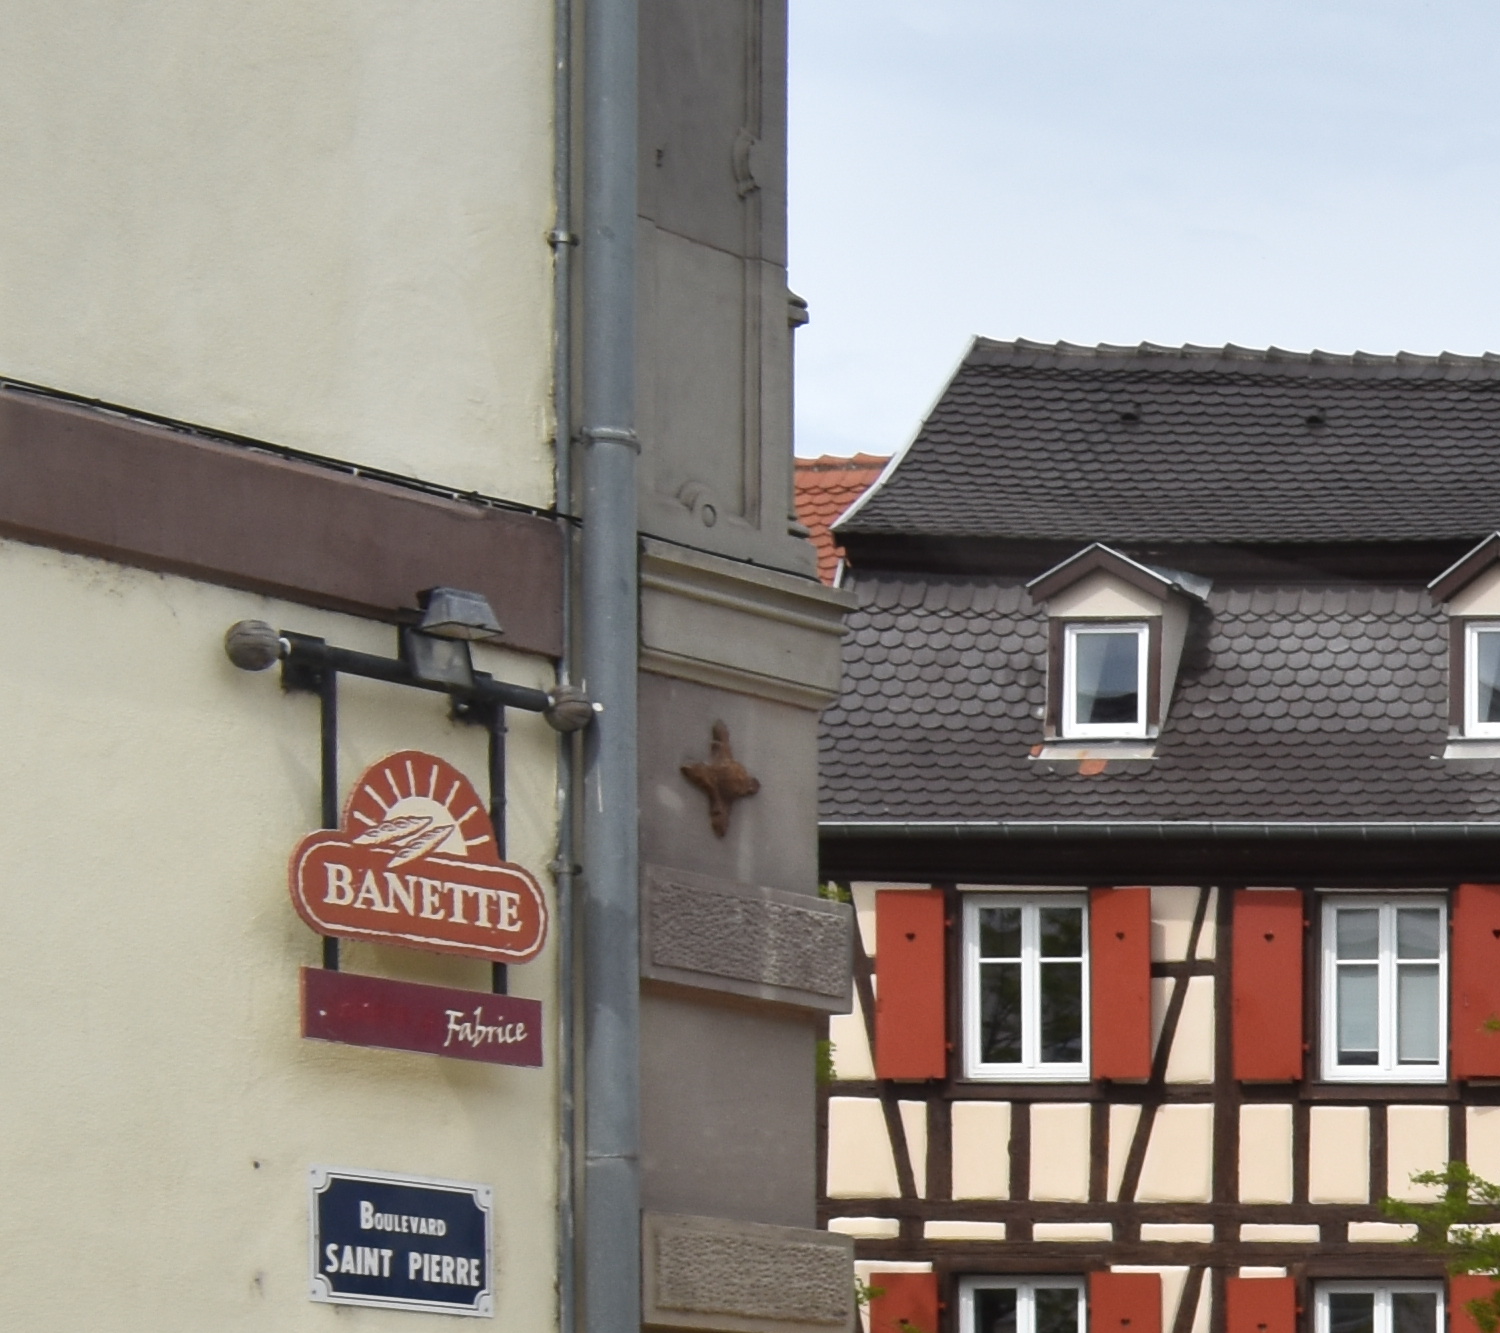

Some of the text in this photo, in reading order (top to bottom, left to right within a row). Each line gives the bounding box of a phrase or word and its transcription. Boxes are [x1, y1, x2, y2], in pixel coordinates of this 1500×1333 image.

[323, 861, 523, 932] BANETTE
[443, 1006, 528, 1047] Fabrice
[325, 1243, 480, 1287] SAINT PIERRE
